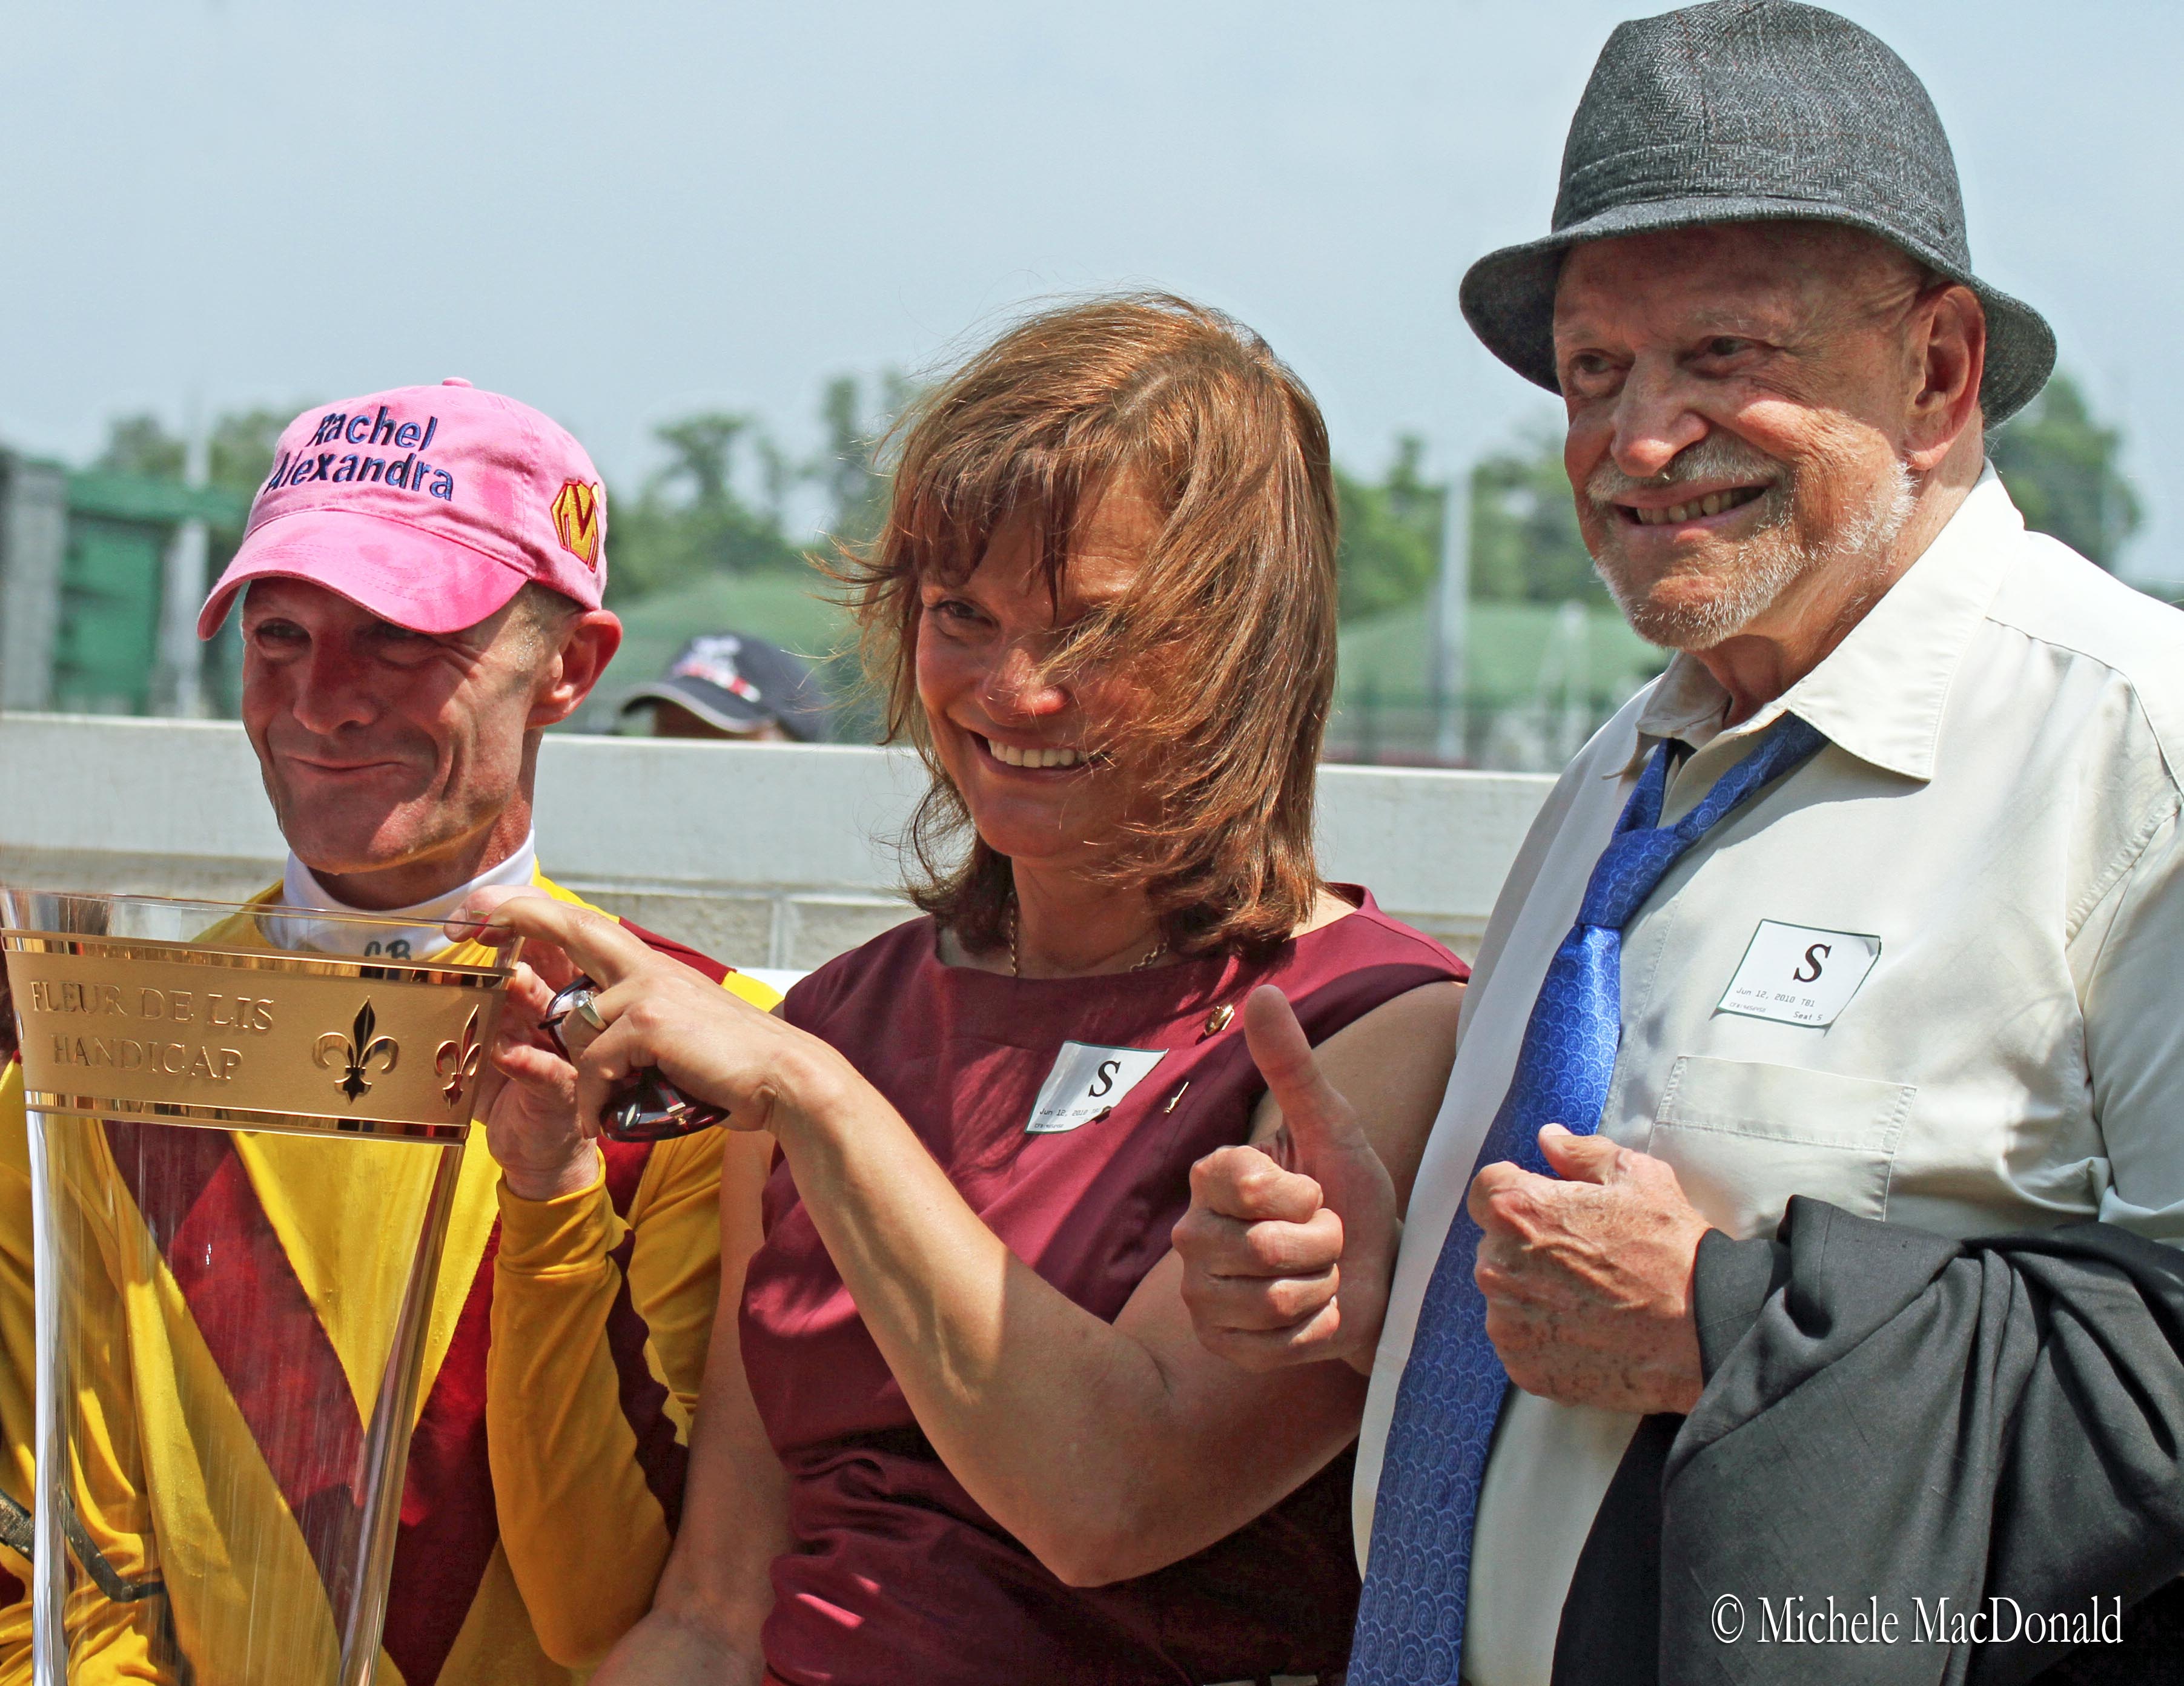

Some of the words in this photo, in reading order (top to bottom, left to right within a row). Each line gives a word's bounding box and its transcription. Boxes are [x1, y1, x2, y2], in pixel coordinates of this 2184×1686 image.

[305, 406, 438, 451] Rachel
[262, 450, 454, 501] Alexandra
[1792, 943, 1832, 983] S
[30, 980, 128, 1016] FLEUR
[137, 987, 194, 1022] DE
[207, 993, 274, 1031] LIS
[1736, 987, 1752, 996] Jun
[1755, 990, 1769, 1000] 12,
[1774, 993, 1796, 1003] 2010
[1793, 1011, 1812, 1020] Seat
[51, 1032, 242, 1080] HANDICAP
[1088, 1060, 1121, 1097] S
